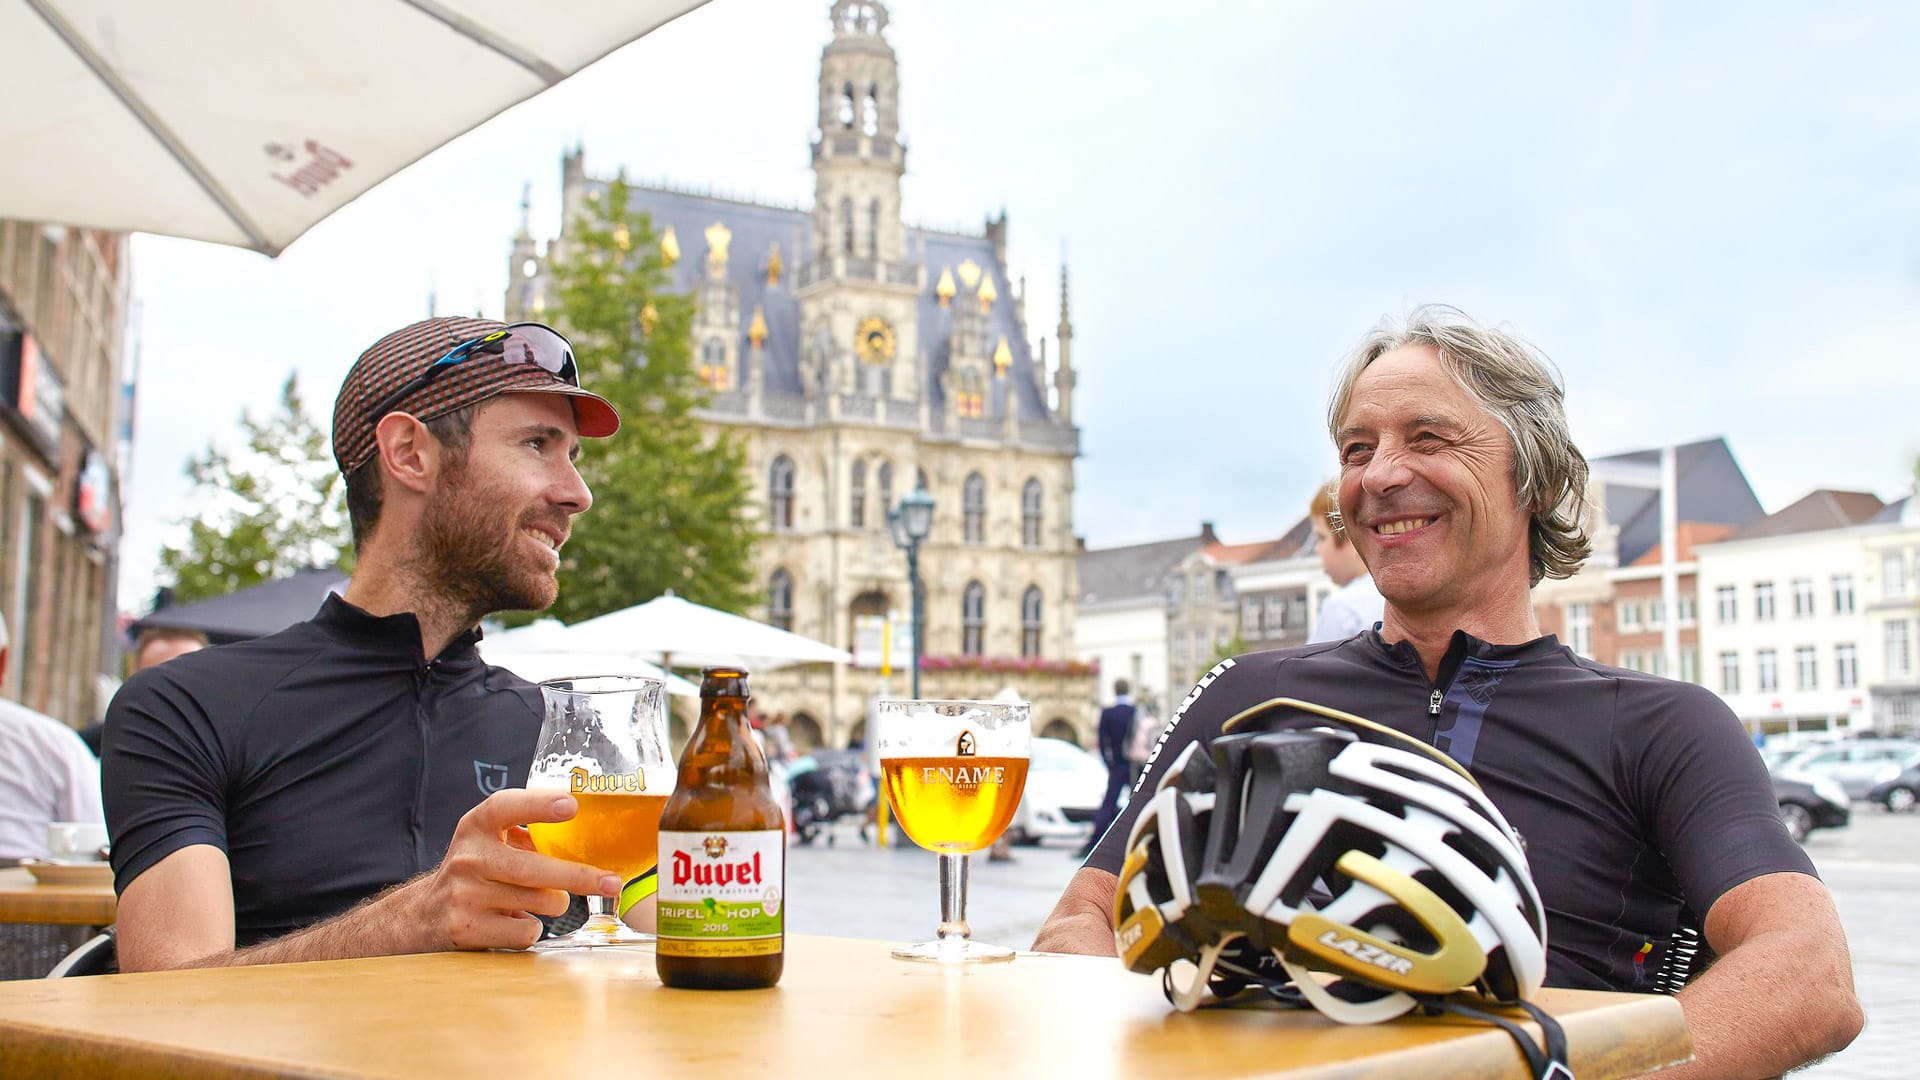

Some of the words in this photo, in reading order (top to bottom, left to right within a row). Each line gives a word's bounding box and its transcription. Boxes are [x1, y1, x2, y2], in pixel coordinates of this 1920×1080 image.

[569, 766, 647, 793] Duvel
[922, 766, 1005, 784] ENAME
[672, 849, 762, 887] Duvel
[661, 907, 704, 919] TRIPEL
[727, 907, 760, 919] HOP
[703, 923, 729, 932] 2015
[1317, 931, 1414, 975] LAZER
